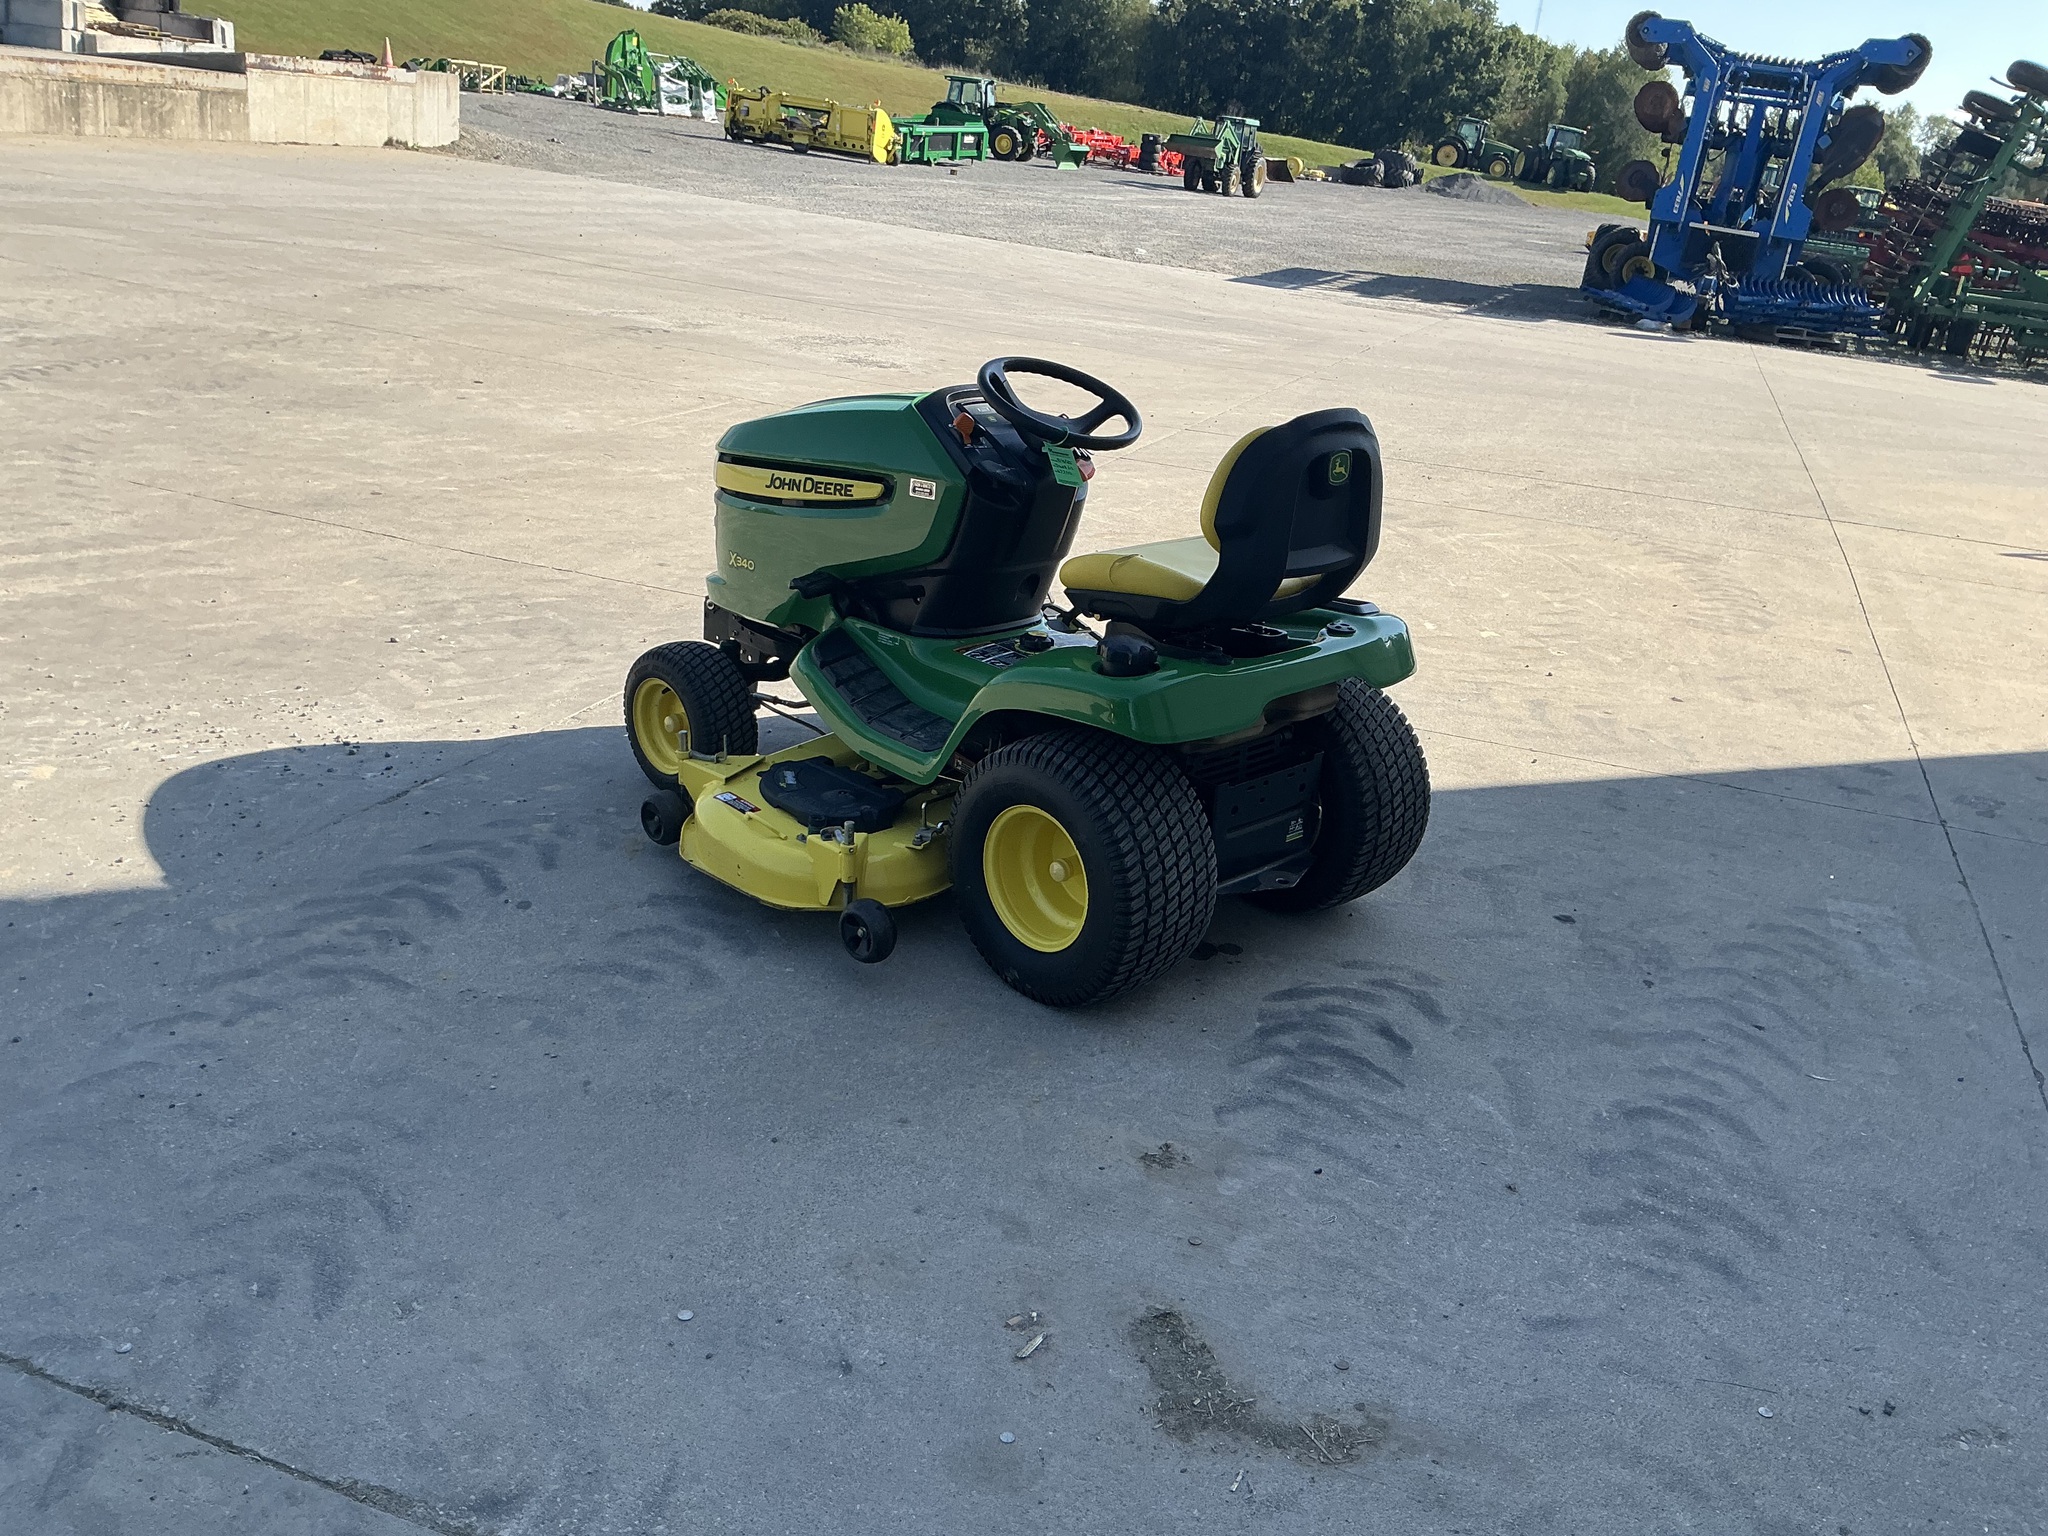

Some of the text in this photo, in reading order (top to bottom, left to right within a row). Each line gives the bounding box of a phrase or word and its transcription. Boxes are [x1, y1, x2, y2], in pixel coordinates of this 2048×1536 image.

[765, 473, 854, 497] JOHN DEERE
[729, 550, 755, 571] X340
